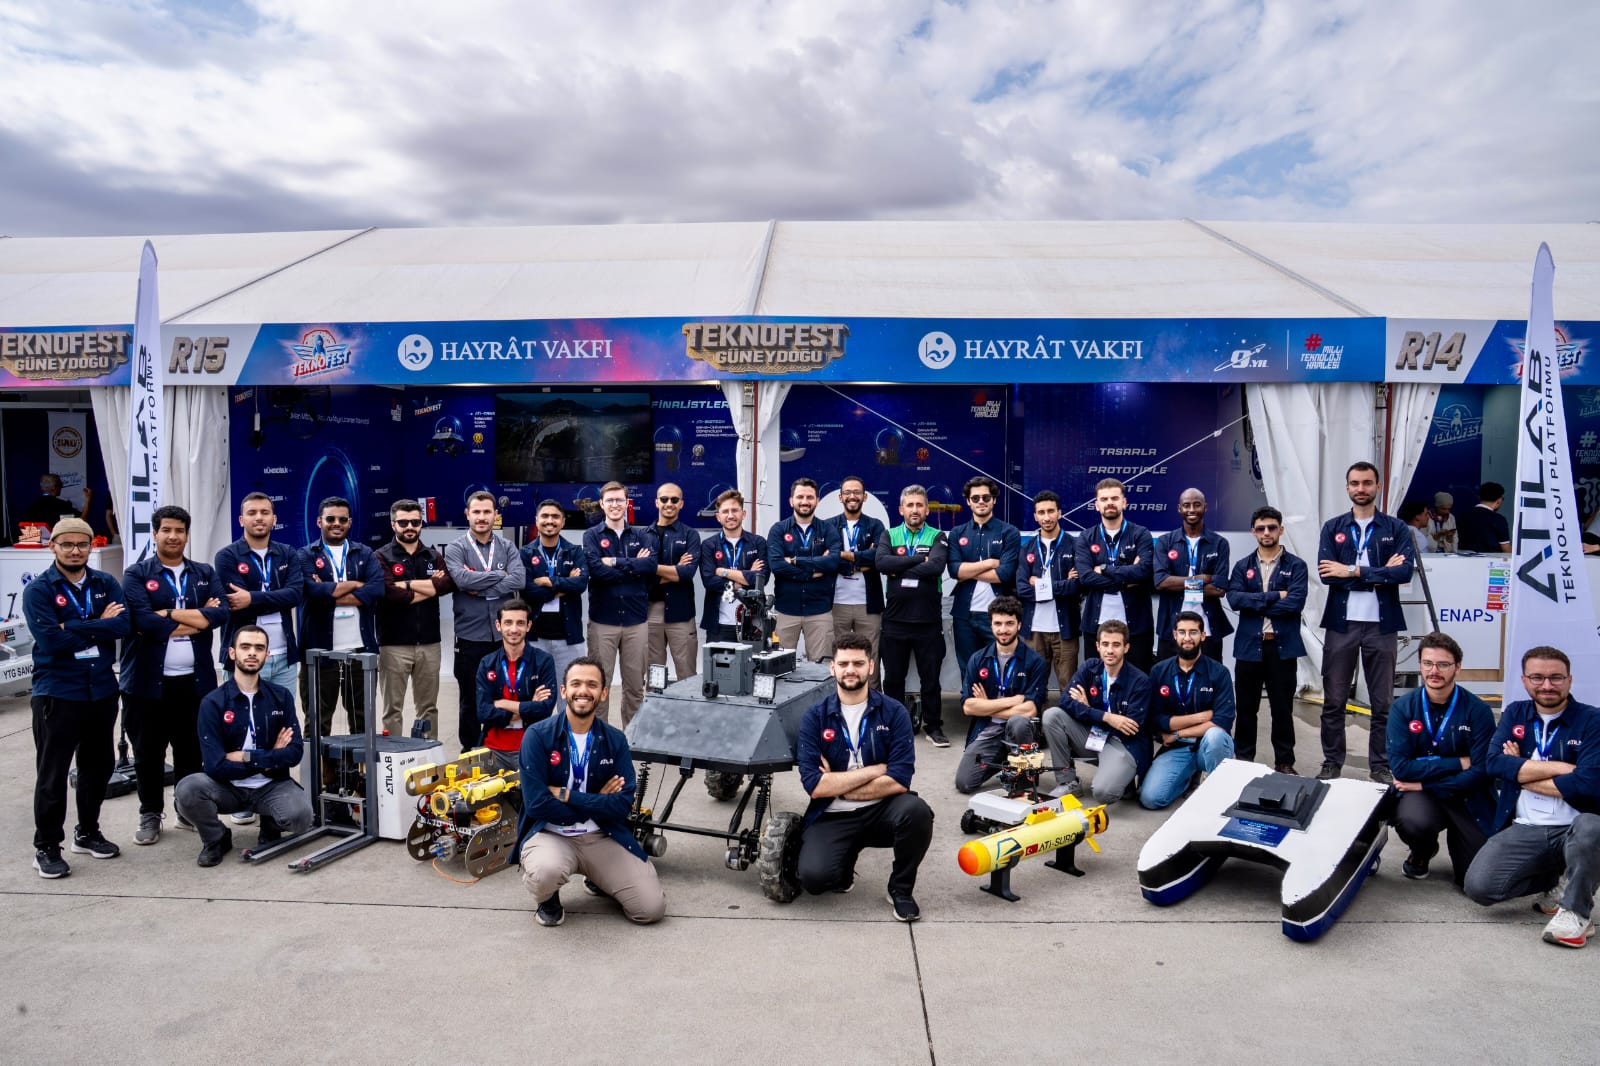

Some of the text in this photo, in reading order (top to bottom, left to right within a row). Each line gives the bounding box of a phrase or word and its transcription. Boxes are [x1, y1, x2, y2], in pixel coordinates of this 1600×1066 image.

[0, 332, 129, 356] EKNOFEST
[440, 336, 613, 361] HAYRÂT VAKFI
[683, 323, 849, 350] TEKNOFEST
[964, 335, 1144, 360] HAYRÂT VAKFI
[15, 356, 110, 371] GÜNEYDOĞU
[168, 336, 230, 374] R15
[293, 350, 351, 377] TEKNOFEST
[715, 348, 823, 364] GÜNEYDOĞU
[1395, 331, 1467, 371] R14
[651, 399, 730, 409] FİNALİSTLER
[1544, 356, 1560, 479] PLATFORMU
[1099, 448, 1157, 456] TASARLA
[1516, 348, 1559, 604] ATILAB
[1136, 485, 1152, 493] ET
[1140, 504, 1168, 512] TAŞI
[384, 755, 394, 796] ATILAB
